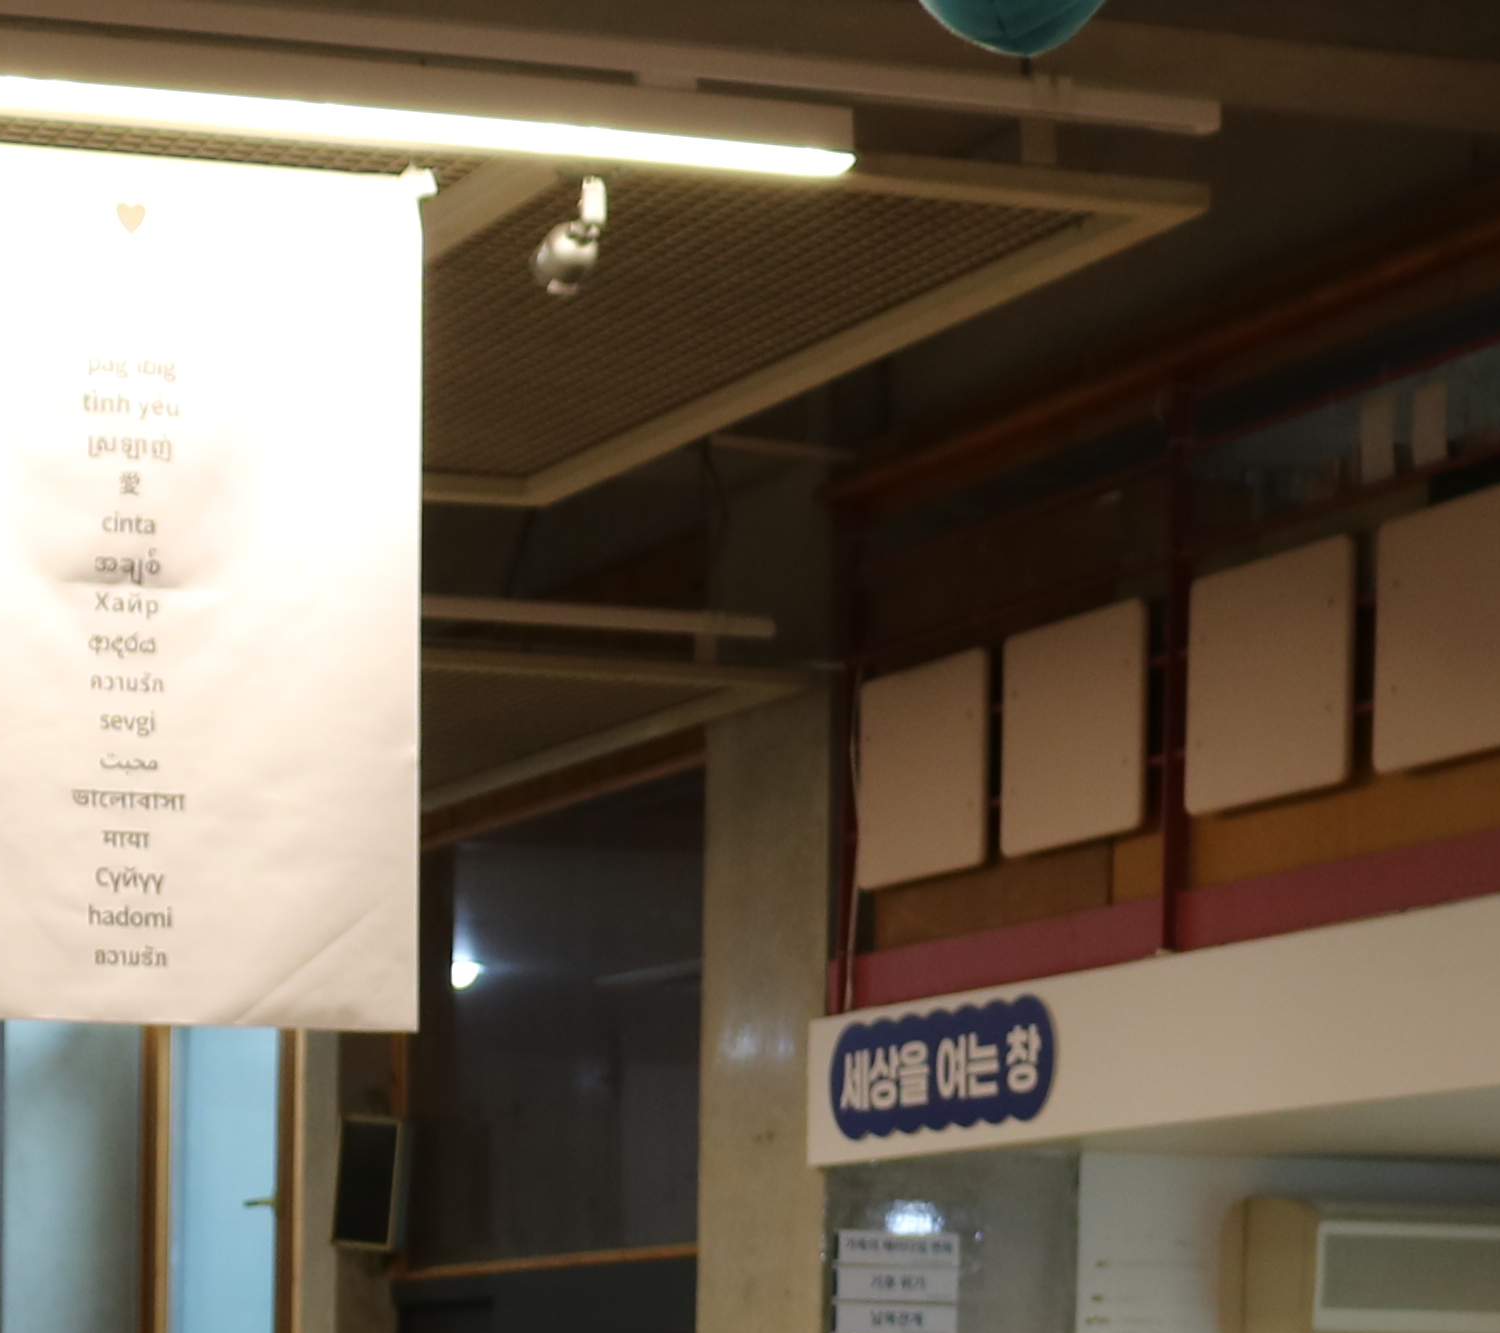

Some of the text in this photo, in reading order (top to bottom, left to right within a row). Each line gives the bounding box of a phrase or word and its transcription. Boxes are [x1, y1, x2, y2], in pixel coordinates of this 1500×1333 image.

[118, 471, 143, 497] 愛
[101, 510, 158, 537] cinta
[94, 590, 161, 620] Хайр
[97, 708, 159, 739] sevgi
[86, 902, 176, 933] hadomi
[840, 1021, 1043, 1112] 세상을 여는 창
